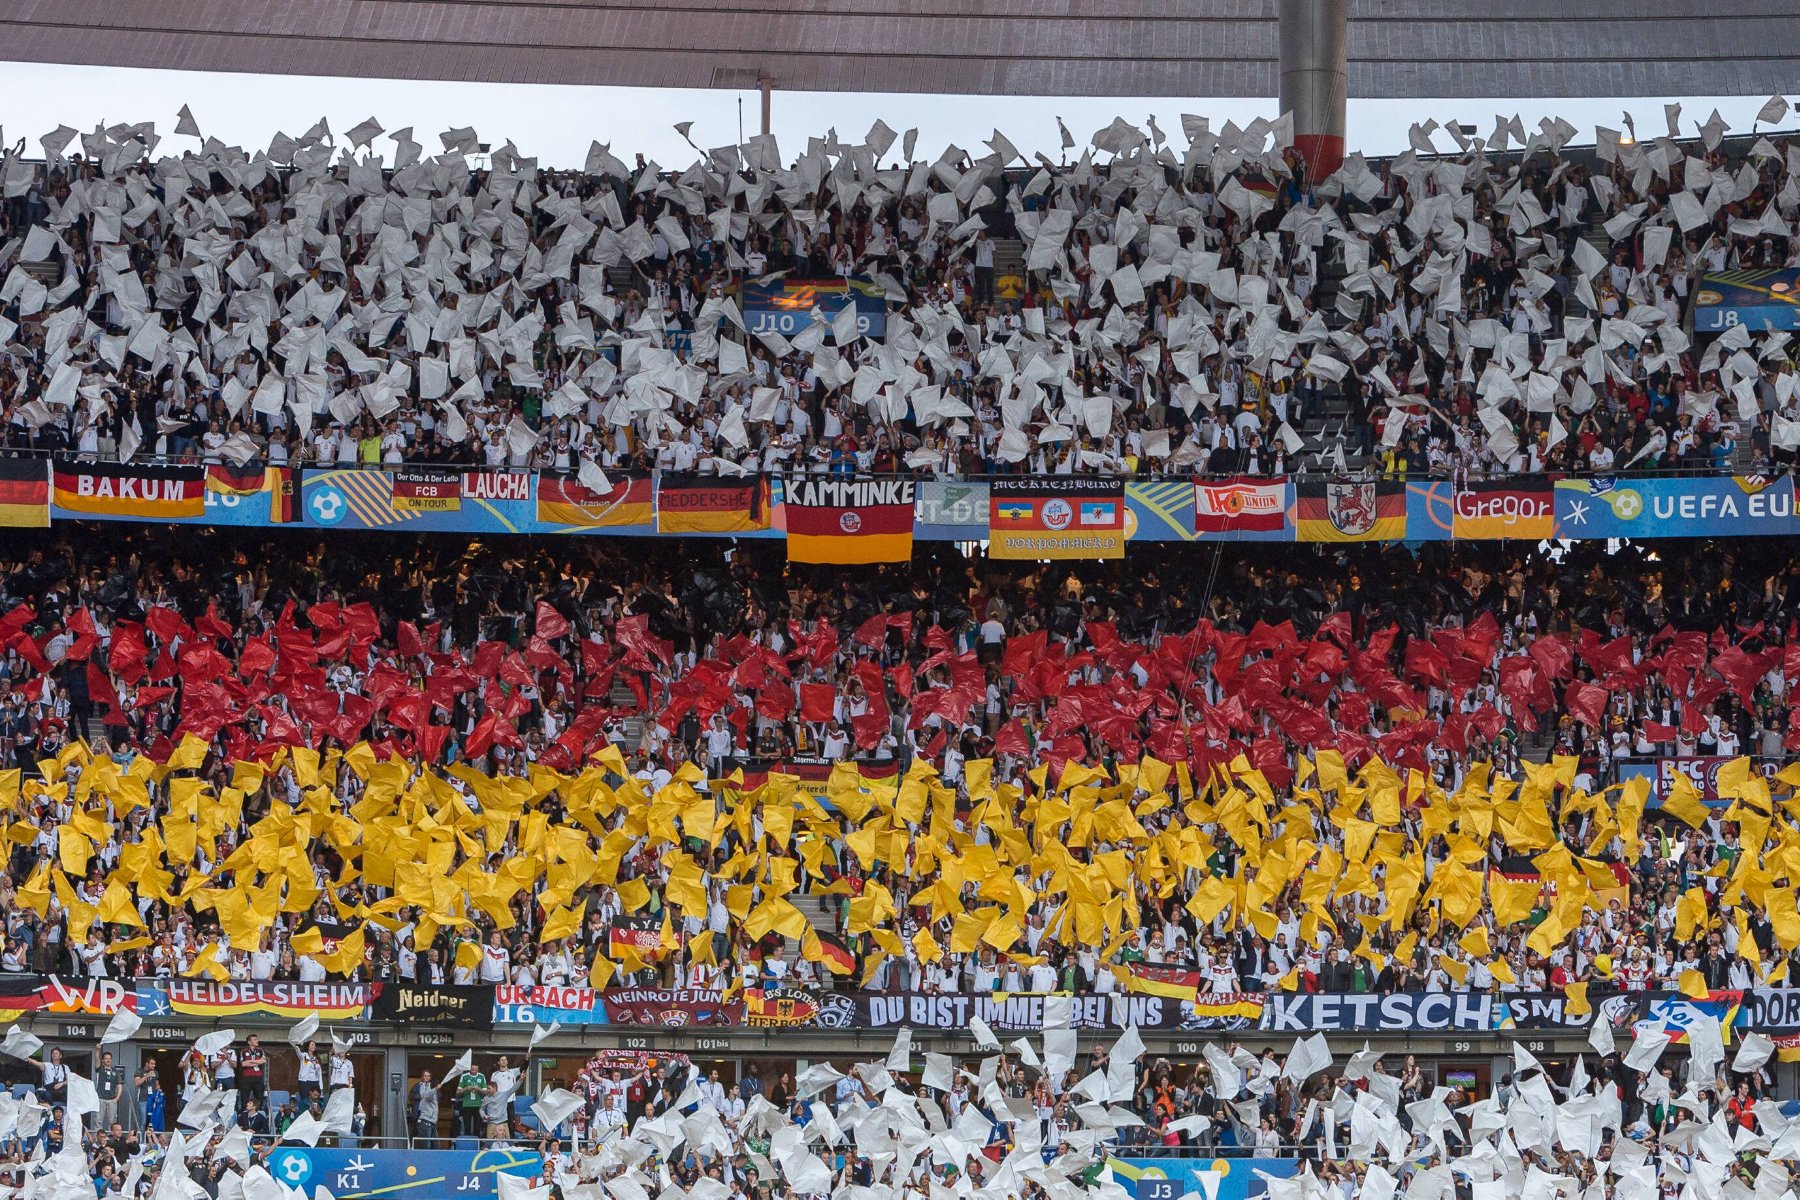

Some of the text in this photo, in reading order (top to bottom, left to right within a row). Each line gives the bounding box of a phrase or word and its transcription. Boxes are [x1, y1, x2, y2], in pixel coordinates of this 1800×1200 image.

[753, 314, 794, 332] J10
[857, 317, 870, 333] 9
[1711, 311, 1738, 328] J8
[78, 475, 184, 501] BAKUM
[415, 486, 438, 496] FCB
[464, 473, 529, 500] LAUCHA
[785, 480, 914, 507] KAMMINKE
[408, 499, 447, 508] ON TOUR
[1457, 490, 1551, 525] Gregor
[1654, 494, 1739, 518] UEFA
[1749, 493, 1789, 517] EU
[1662, 760, 1705, 779] BFC
[49, 974, 125, 1014] WR
[169, 981, 363, 1006] HEIDELSHEIM
[496, 986, 595, 1010] URBACH
[609, 990, 689, 1005] WEINROTE
[869, 996, 1162, 1027] DU BIST IMME BEI UNS
[1274, 994, 1492, 1030] KETSCH
[66, 1026, 86, 1036] 104
[152, 1028, 185, 1038] 103 bis
[351, 1033, 371, 1042] 103
[419, 1034, 439, 1044] 102
[626, 1039, 646, 1048] 102
[697, 1039, 729, 1049] 101 bis
[910, 1042, 922, 1051] 01
[1177, 1043, 1197, 1053] 100
[1455, 1042, 1470, 1052] 99
[1529, 1042, 1544, 1051] 98
[337, 1173, 360, 1189] K1
[457, 1175, 481, 1191] J4
[1150, 1184, 1172, 1198] J3
